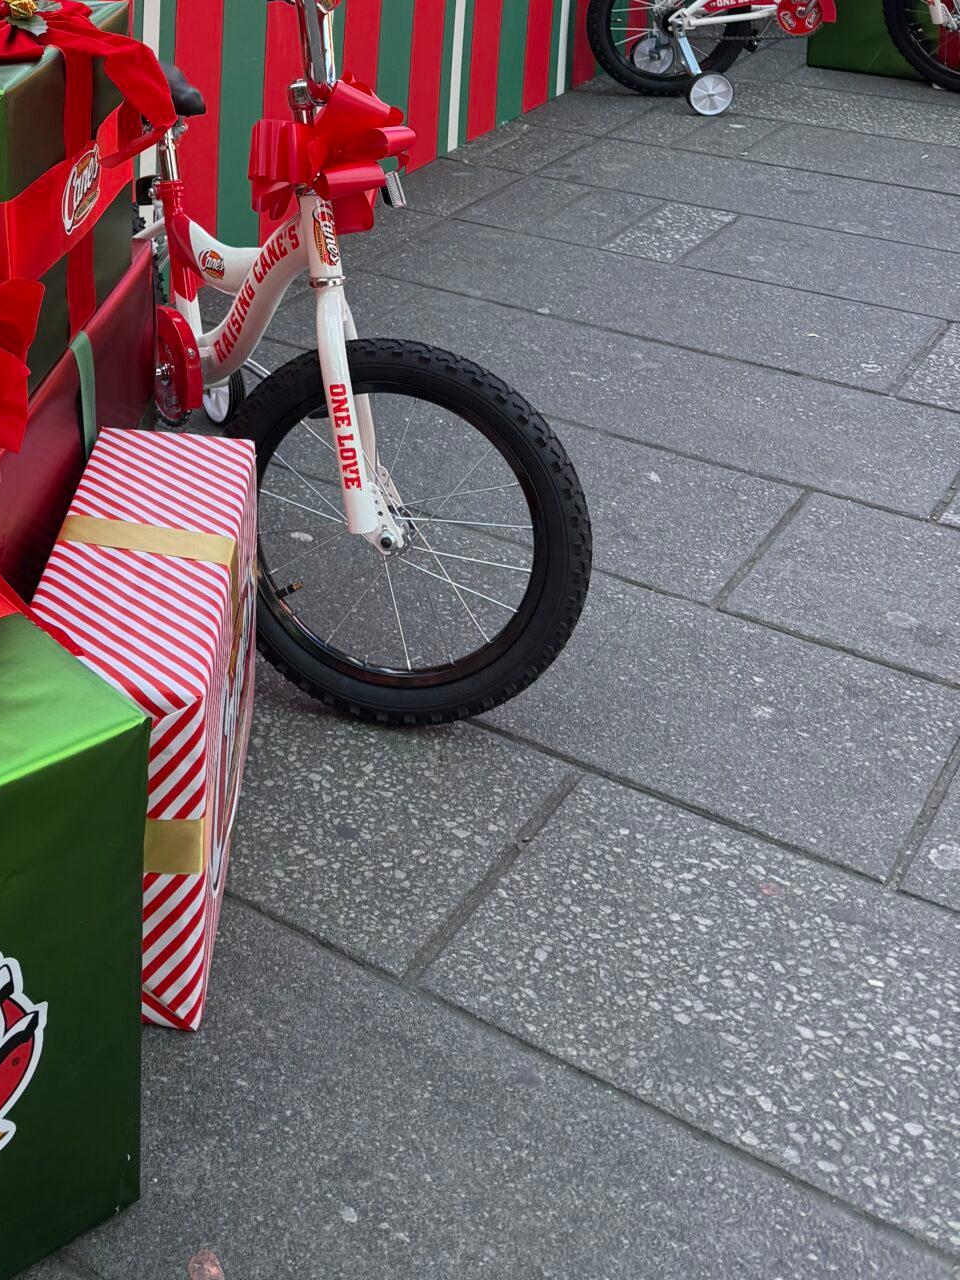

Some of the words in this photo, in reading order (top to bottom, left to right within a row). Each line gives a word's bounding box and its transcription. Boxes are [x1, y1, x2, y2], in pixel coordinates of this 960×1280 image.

[252, 224, 300, 284] CANE'S
[213, 279, 256, 363] RAISING
[329, 383, 352, 429] ONE
[337, 433, 362, 491] LOVE
